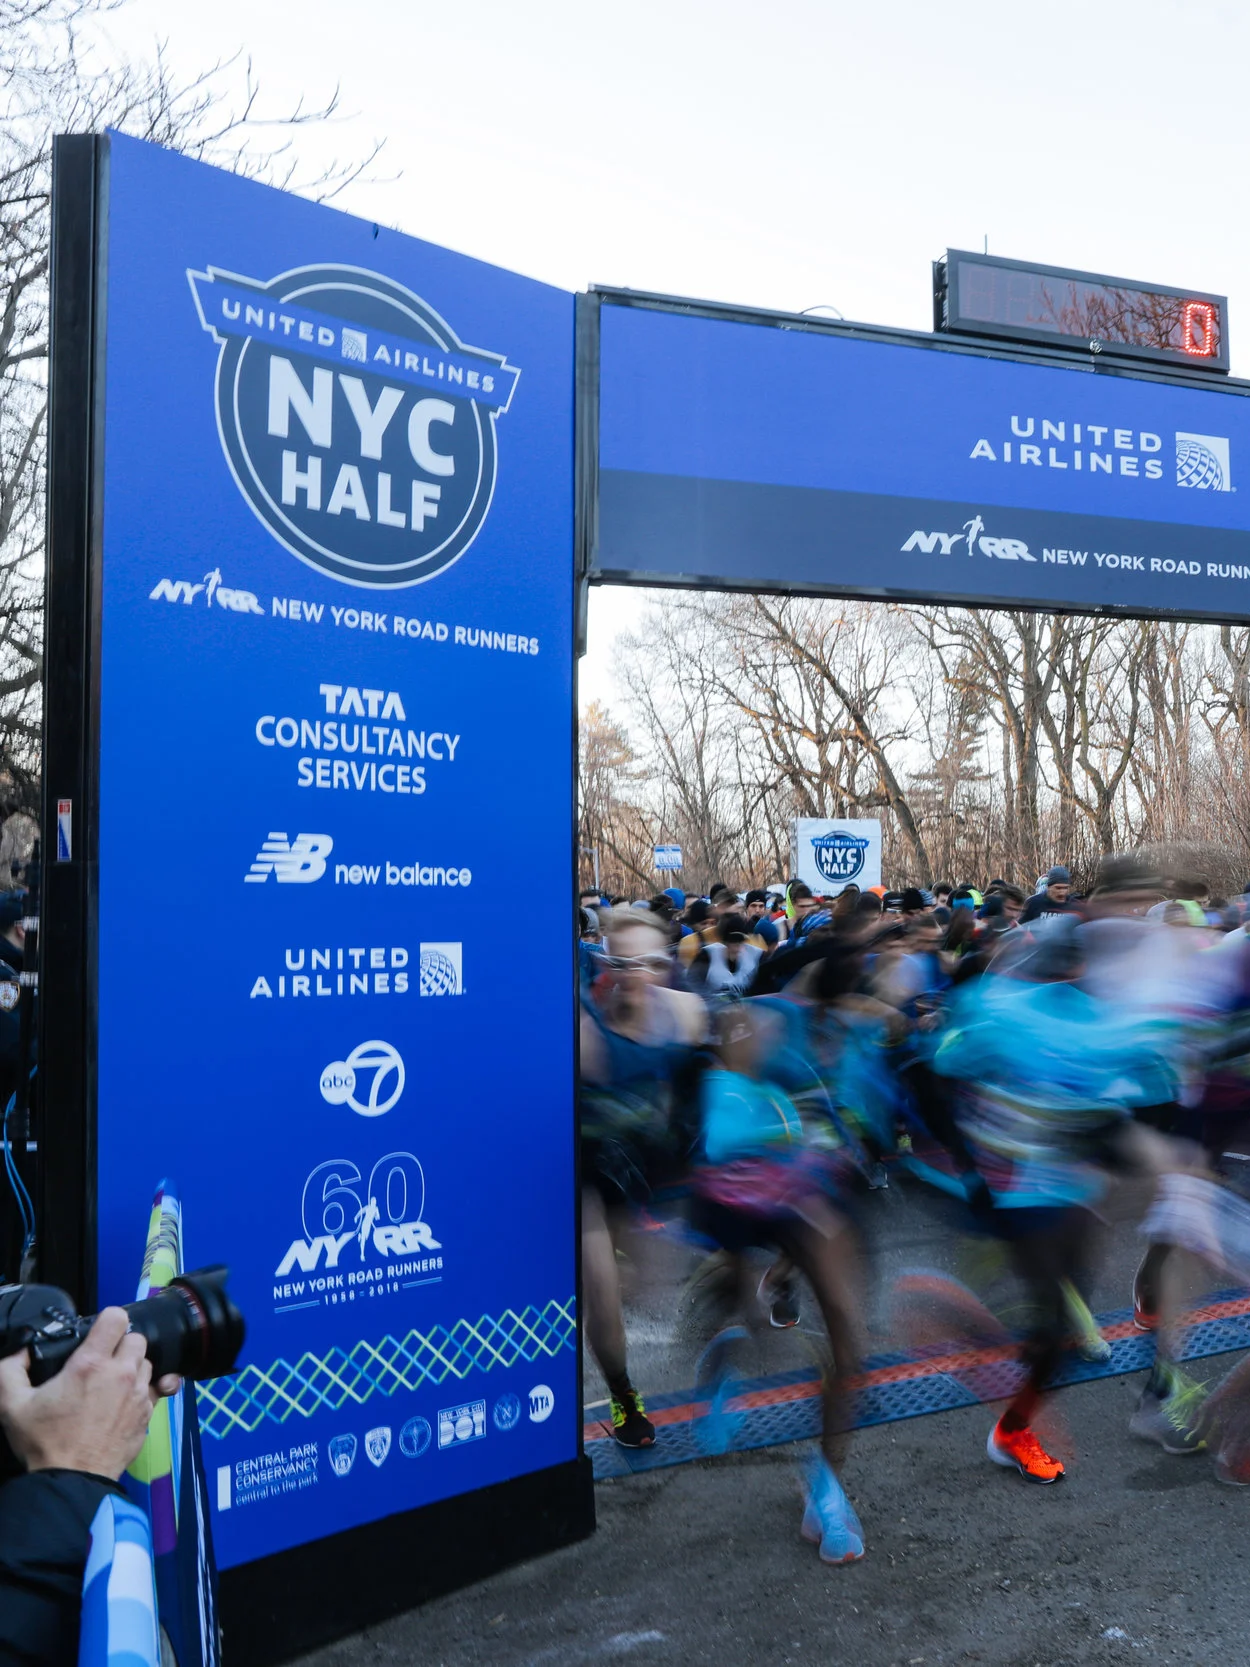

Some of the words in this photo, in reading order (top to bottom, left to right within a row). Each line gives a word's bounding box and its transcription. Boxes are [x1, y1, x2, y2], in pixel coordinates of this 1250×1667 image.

[222, 298, 335, 347] UNITED
[373, 344, 495, 393] AIRLINES
[267, 354, 455, 477] NYC
[1010, 415, 1163, 452] UNITED
[969, 438, 1164, 480] AIRLINES
[281, 450, 441, 532] HALF
[1042, 547, 1089, 567] NEW
[1093, 552, 1146, 572] YORK
[1150, 556, 1202, 576] ROAD
[272, 597, 324, 623] NEW
[330, 606, 388, 633] YORK
[394, 616, 449, 643] ROAD
[454, 624, 539, 655] RUNNERS
[320, 683, 406, 721] TATA
[255, 715, 460, 761] CONSULTANCY
[297, 757, 426, 795] SERVICES
[821, 847, 857, 863] NYC
[823, 863, 854, 875] HALF
[335, 862, 381, 885] new
[385, 861, 472, 887] balance
[285, 947, 408, 971] UNITED
[250, 972, 409, 999] AIRLINES
[322, 1072, 354, 1089] abc
[302, 1152, 425, 1243] 60
[273, 1281, 305, 1300] NEW
[308, 1275, 344, 1294] YORK
[348, 1268, 383, 1285] ROAD
[387, 1257, 443, 1278] RUNNERS
[235, 1451, 288, 1476] CENTRAL
[289, 1441, 318, 1461] PARK
[235, 1455, 319, 1491] CONSERVANCY
